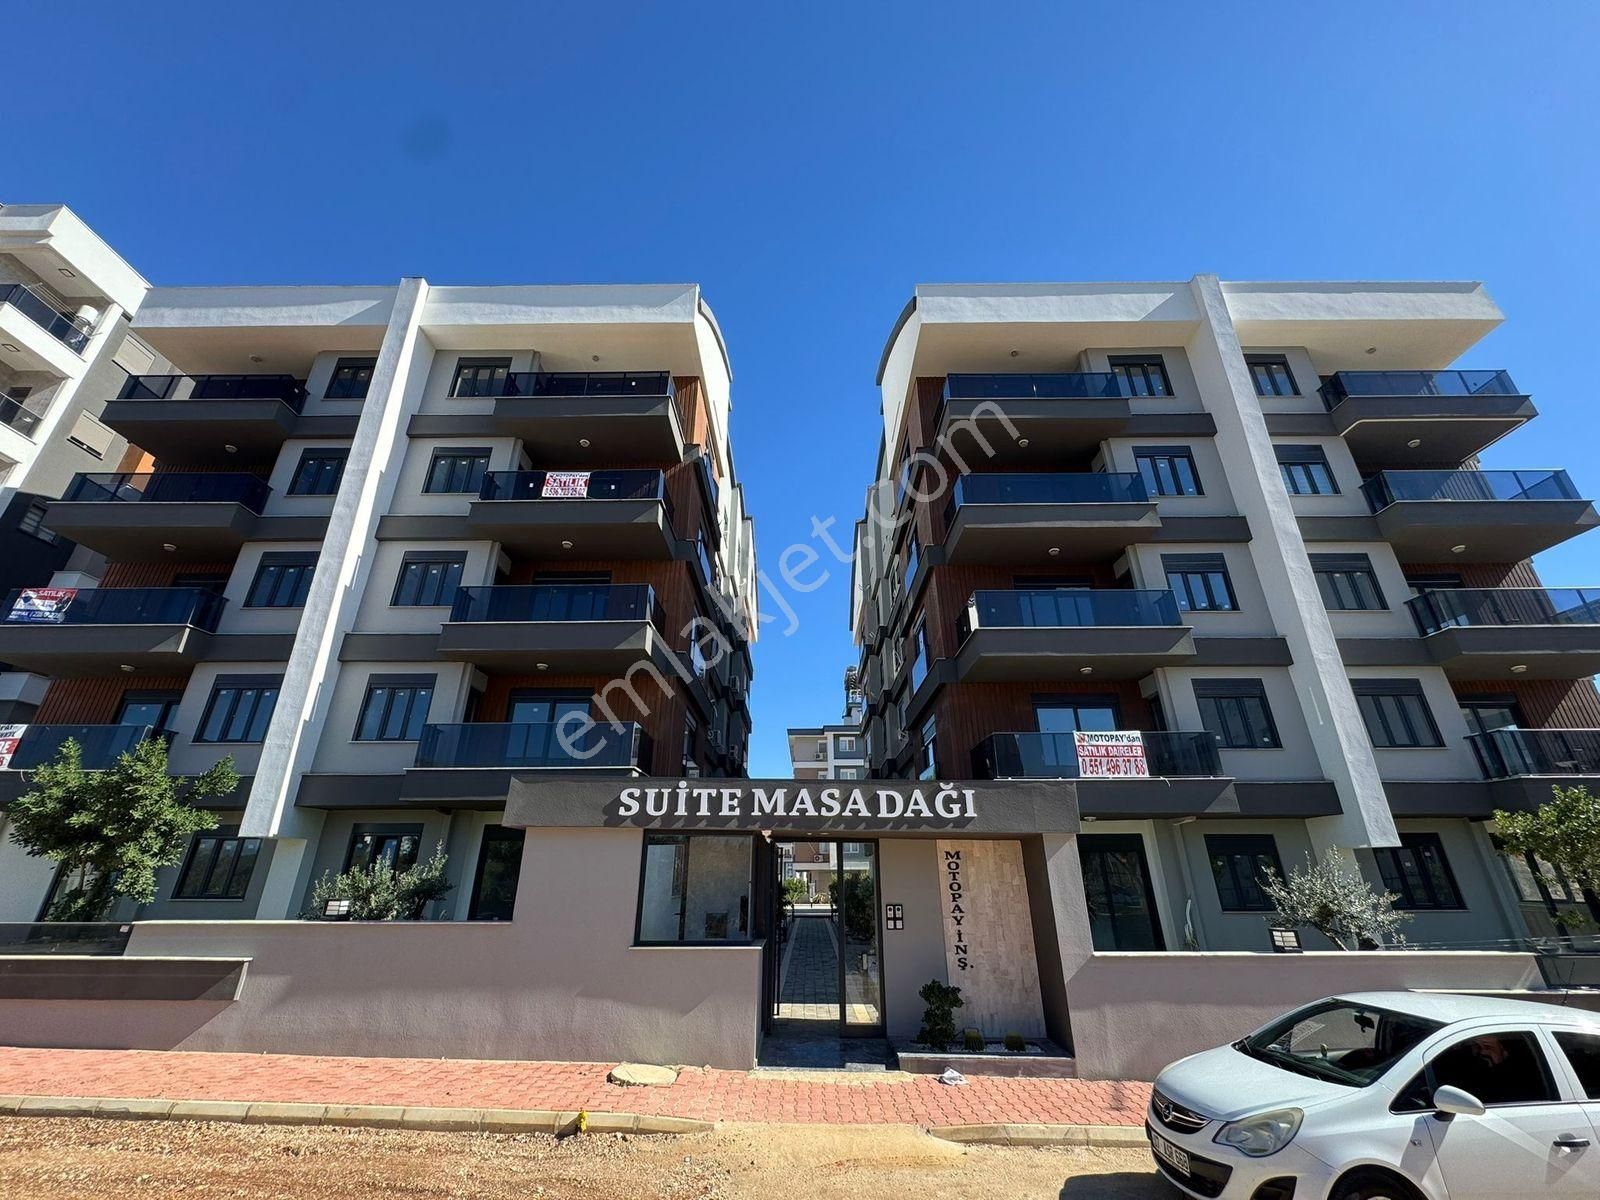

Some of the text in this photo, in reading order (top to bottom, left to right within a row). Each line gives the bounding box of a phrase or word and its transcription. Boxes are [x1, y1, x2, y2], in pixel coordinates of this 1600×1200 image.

[546, 477, 587, 487] SATILIK
[1087, 733, 1141, 743] MOTOPAY'dan
[1079, 746, 1107, 757] SATILIK
[1081, 758, 1088, 775] 0
[1089, 758, 1104, 775] 551
[1106, 758, 1121, 775] 496
[1122, 758, 1132, 775] 37
[618, 780, 978, 818] SUİTE MASA DAĞI
[943, 850, 965, 926] MOTOPAY
